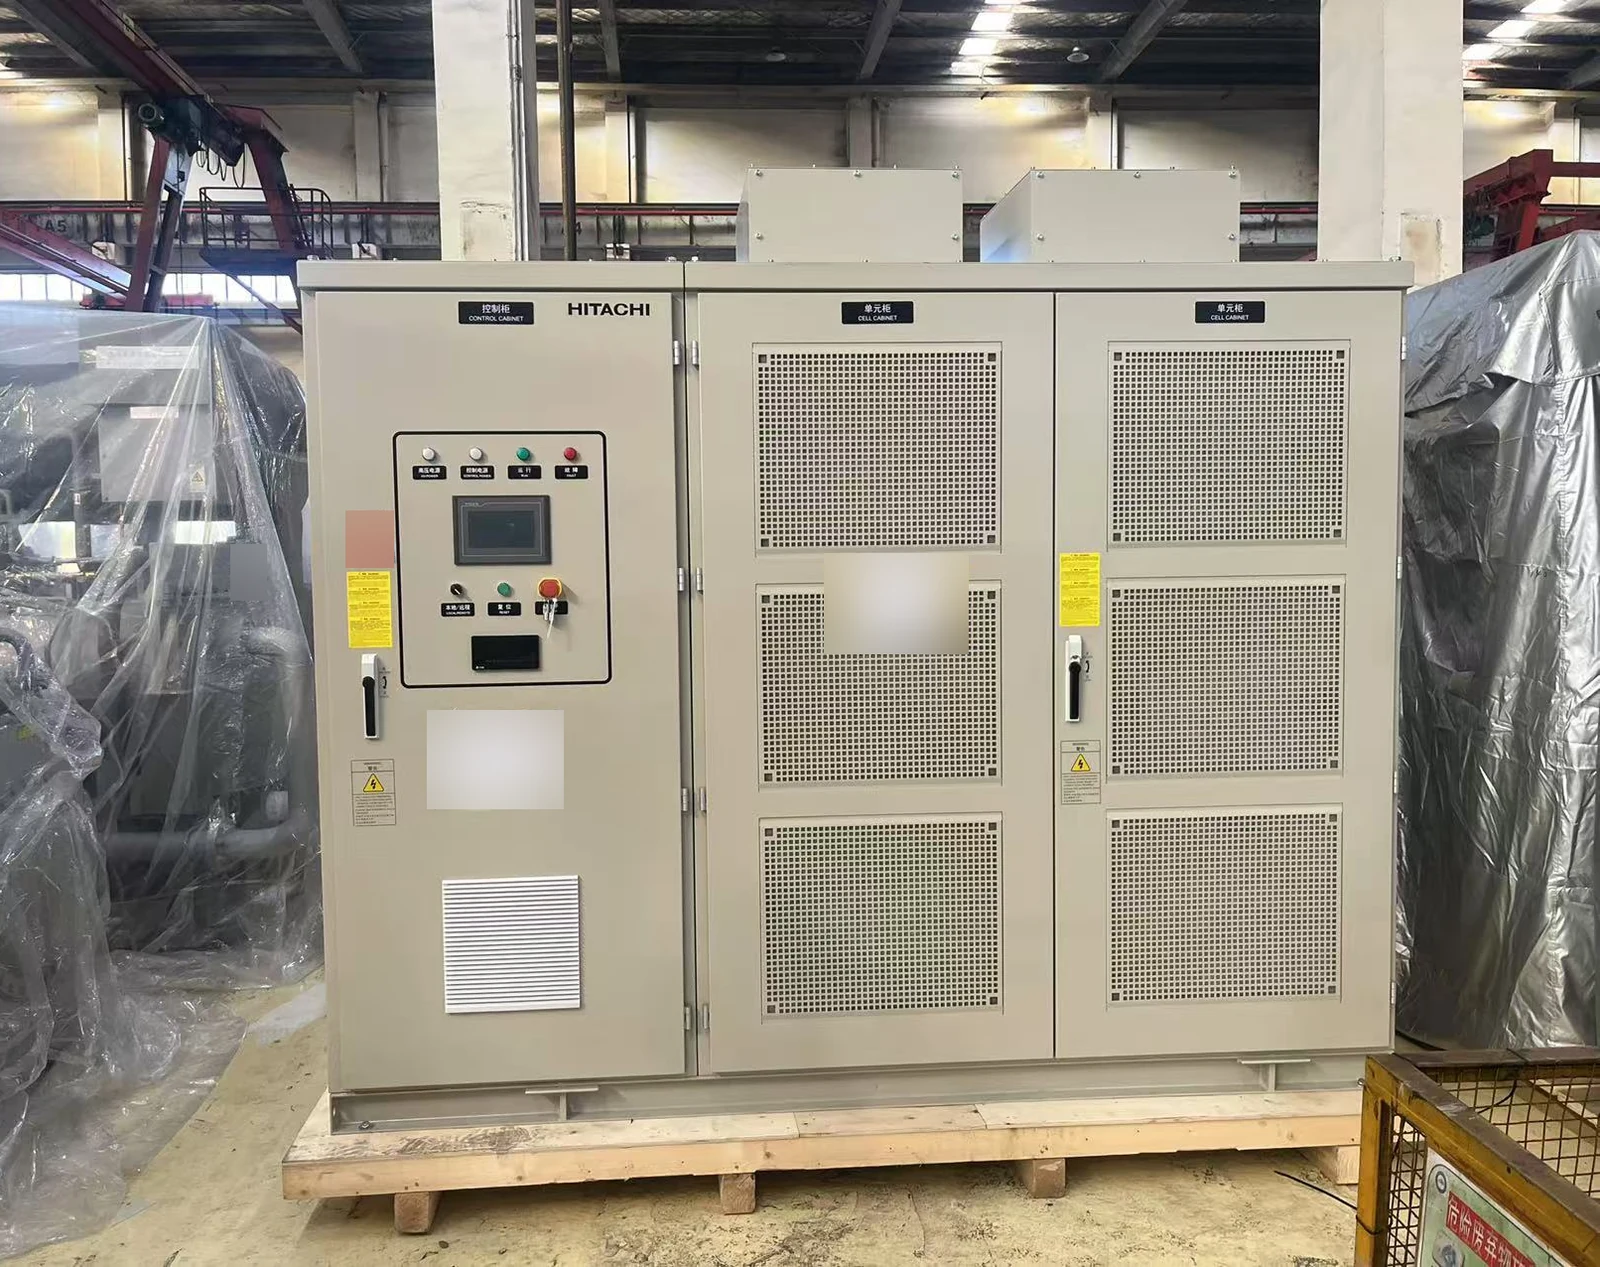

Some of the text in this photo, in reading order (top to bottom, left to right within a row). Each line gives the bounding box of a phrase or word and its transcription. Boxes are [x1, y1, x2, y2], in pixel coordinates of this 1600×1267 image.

[45, 220, 67, 233] A5
[481, 303, 511, 314] 控制柜
[568, 302, 650, 316] HITACHI
[864, 303, 892, 313] 单元柜
[1217, 303, 1244, 313] 单元柜
